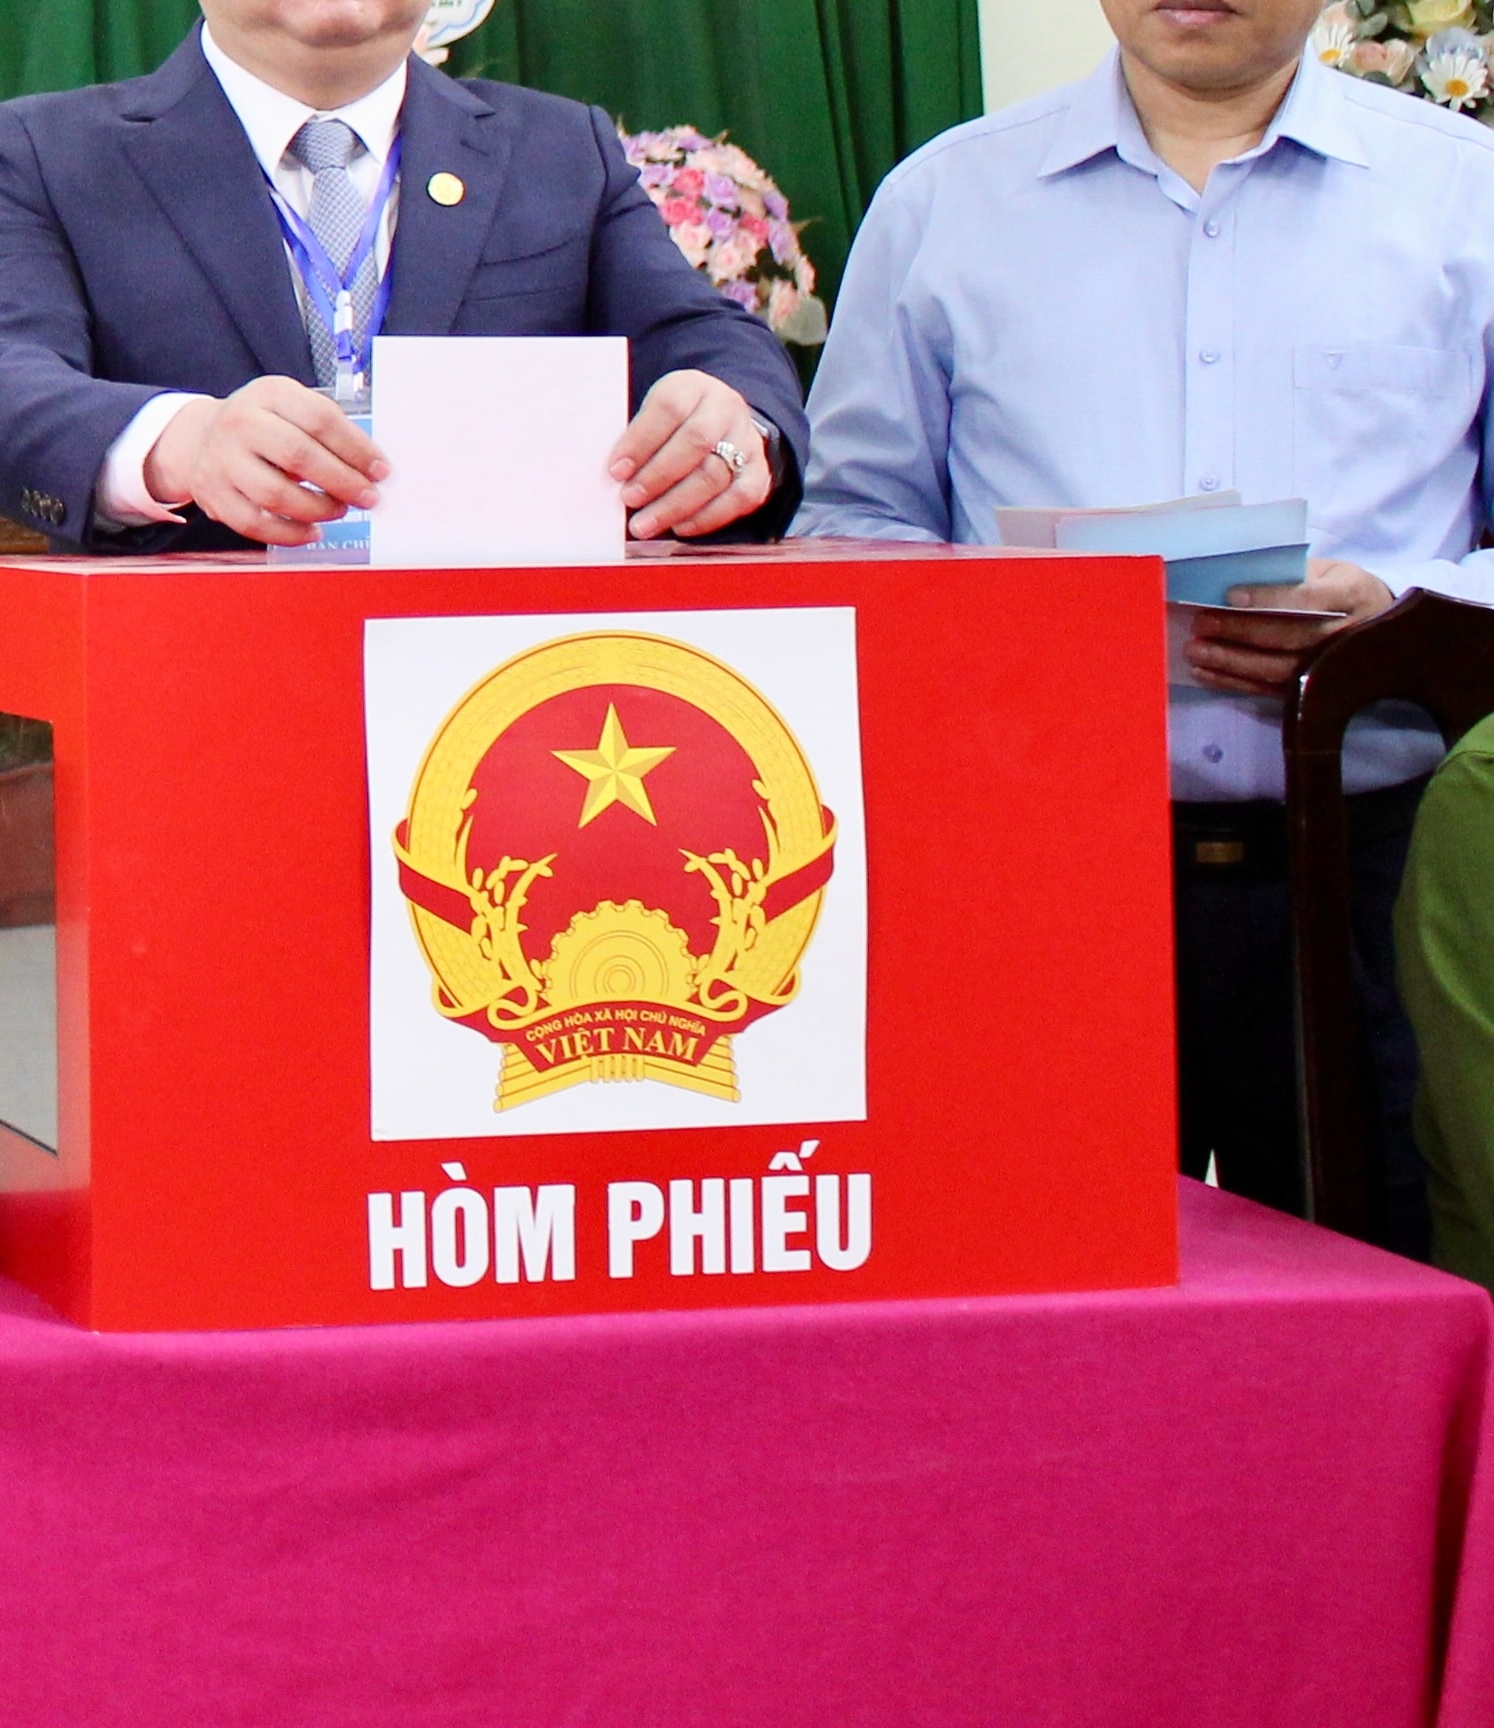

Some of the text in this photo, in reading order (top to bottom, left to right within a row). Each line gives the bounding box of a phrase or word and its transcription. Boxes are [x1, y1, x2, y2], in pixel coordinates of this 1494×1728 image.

[535, 1026, 699, 1065] VIỆT NAM
[367, 1139, 872, 1290] HÒM PHIẾU
